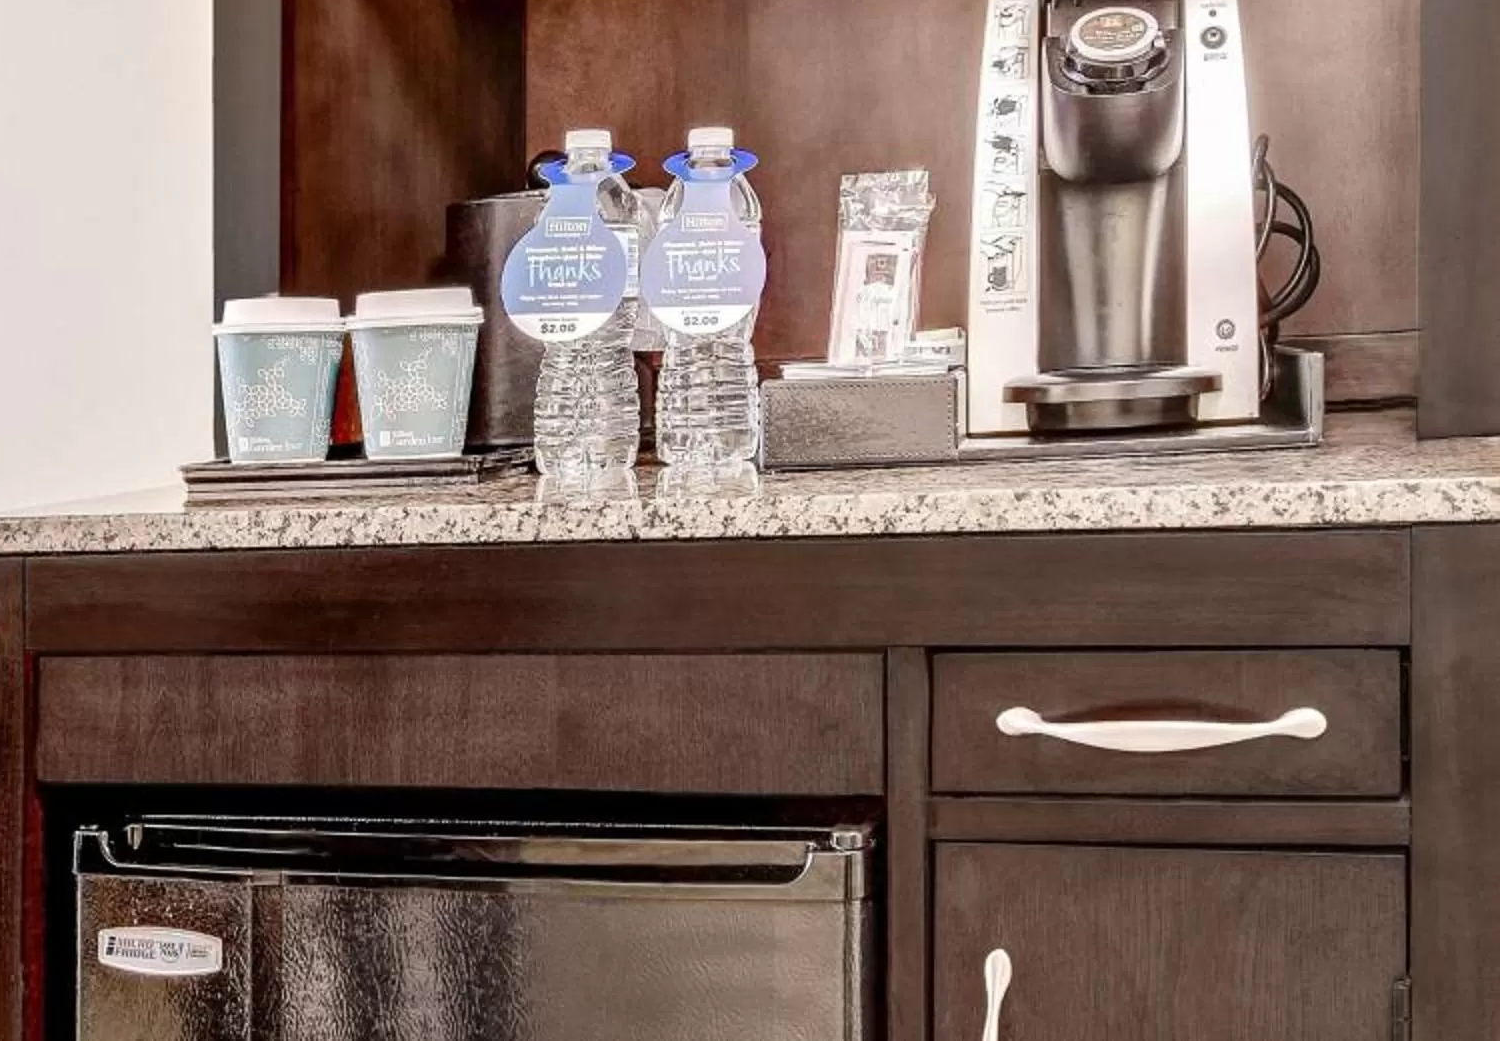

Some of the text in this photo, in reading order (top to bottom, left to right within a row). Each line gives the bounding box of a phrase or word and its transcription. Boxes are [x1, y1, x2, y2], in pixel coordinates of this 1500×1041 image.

[547, 220, 588, 233] Hilton
[526, 253, 603, 288] Thanks
[664, 249, 741, 282] Thanks
[683, 316, 720, 327] $2.00
[540, 322, 578, 335] $2.00
